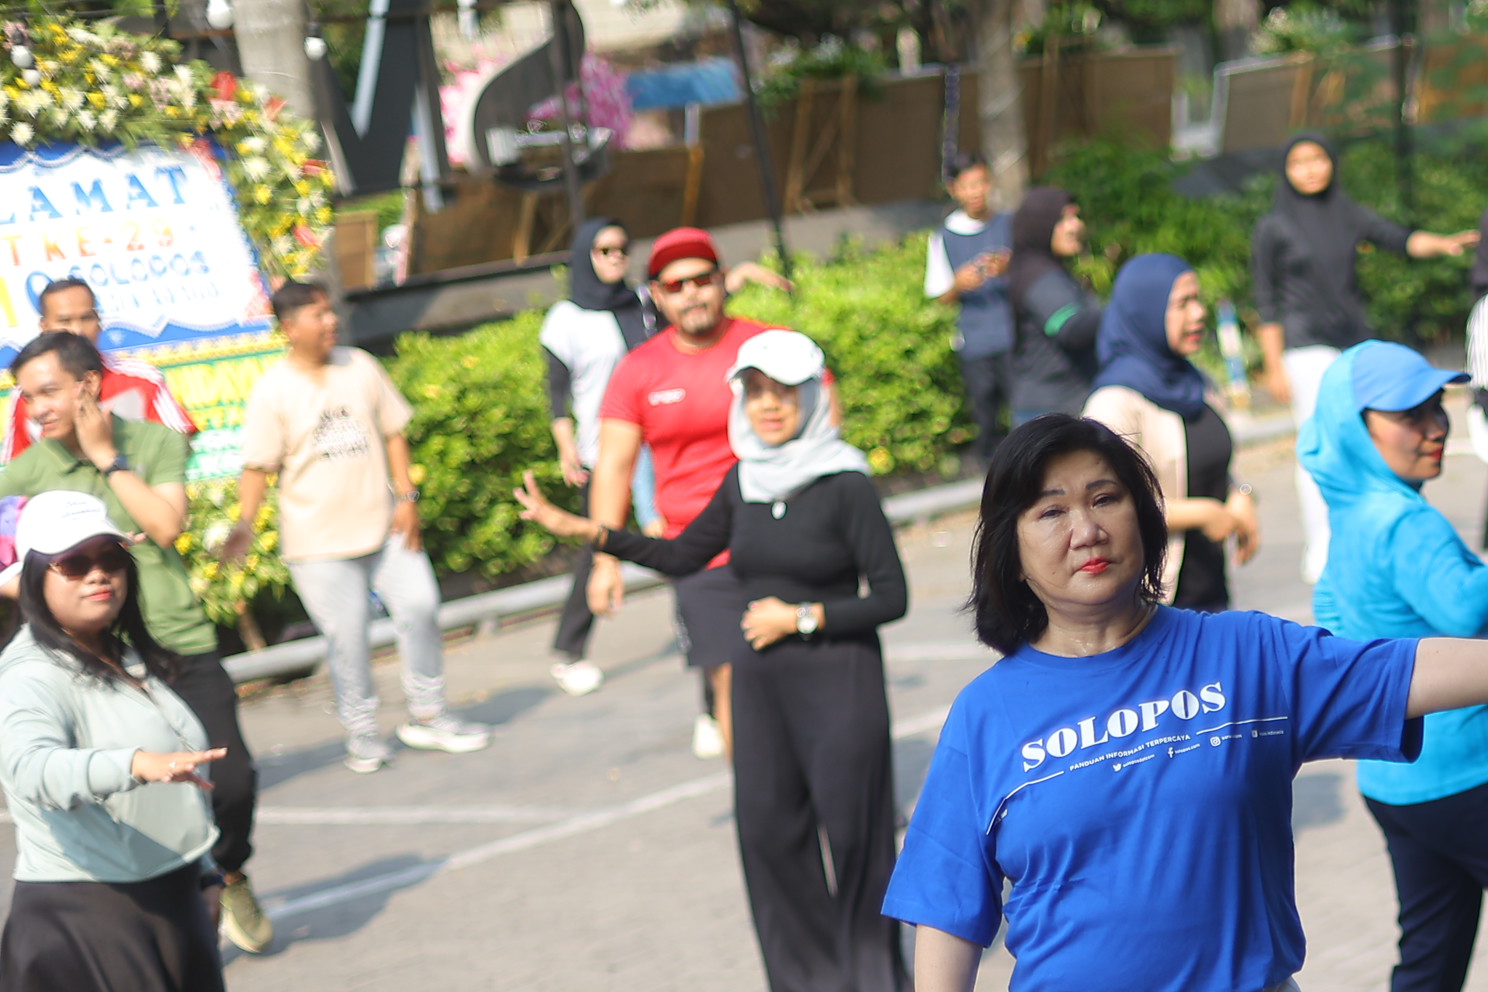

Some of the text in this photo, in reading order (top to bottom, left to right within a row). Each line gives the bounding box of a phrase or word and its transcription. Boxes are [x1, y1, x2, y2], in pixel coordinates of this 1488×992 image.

[1022, 682, 1226, 772] SOLOPOS
[1069, 733, 1191, 772] PANDUAN INFORMASI TERPERCAYA
